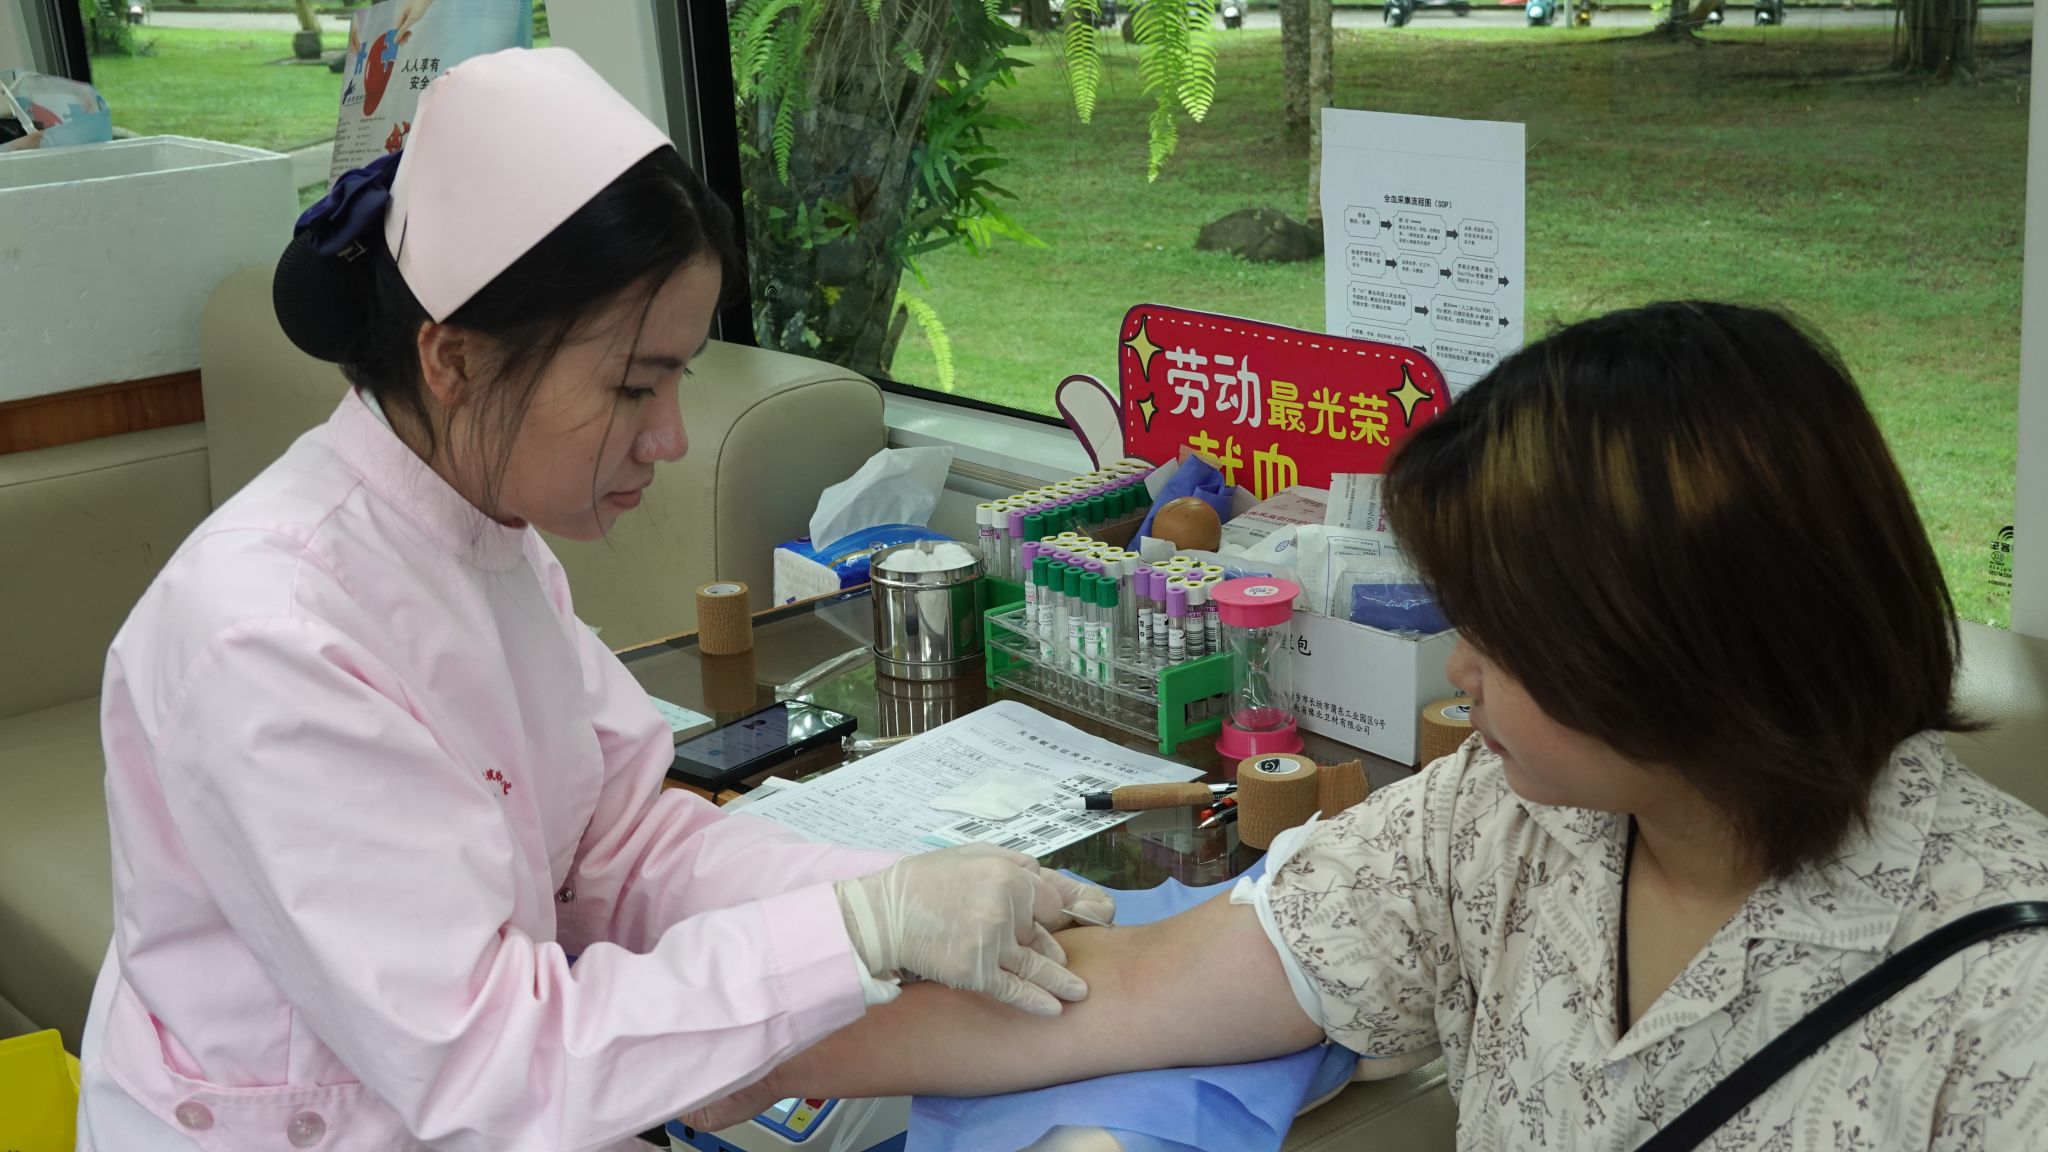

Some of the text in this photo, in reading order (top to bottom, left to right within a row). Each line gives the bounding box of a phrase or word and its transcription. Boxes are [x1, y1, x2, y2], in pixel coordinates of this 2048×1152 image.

[400, 57, 440, 73] 人人享有
[409, 75, 437, 90] 安全
